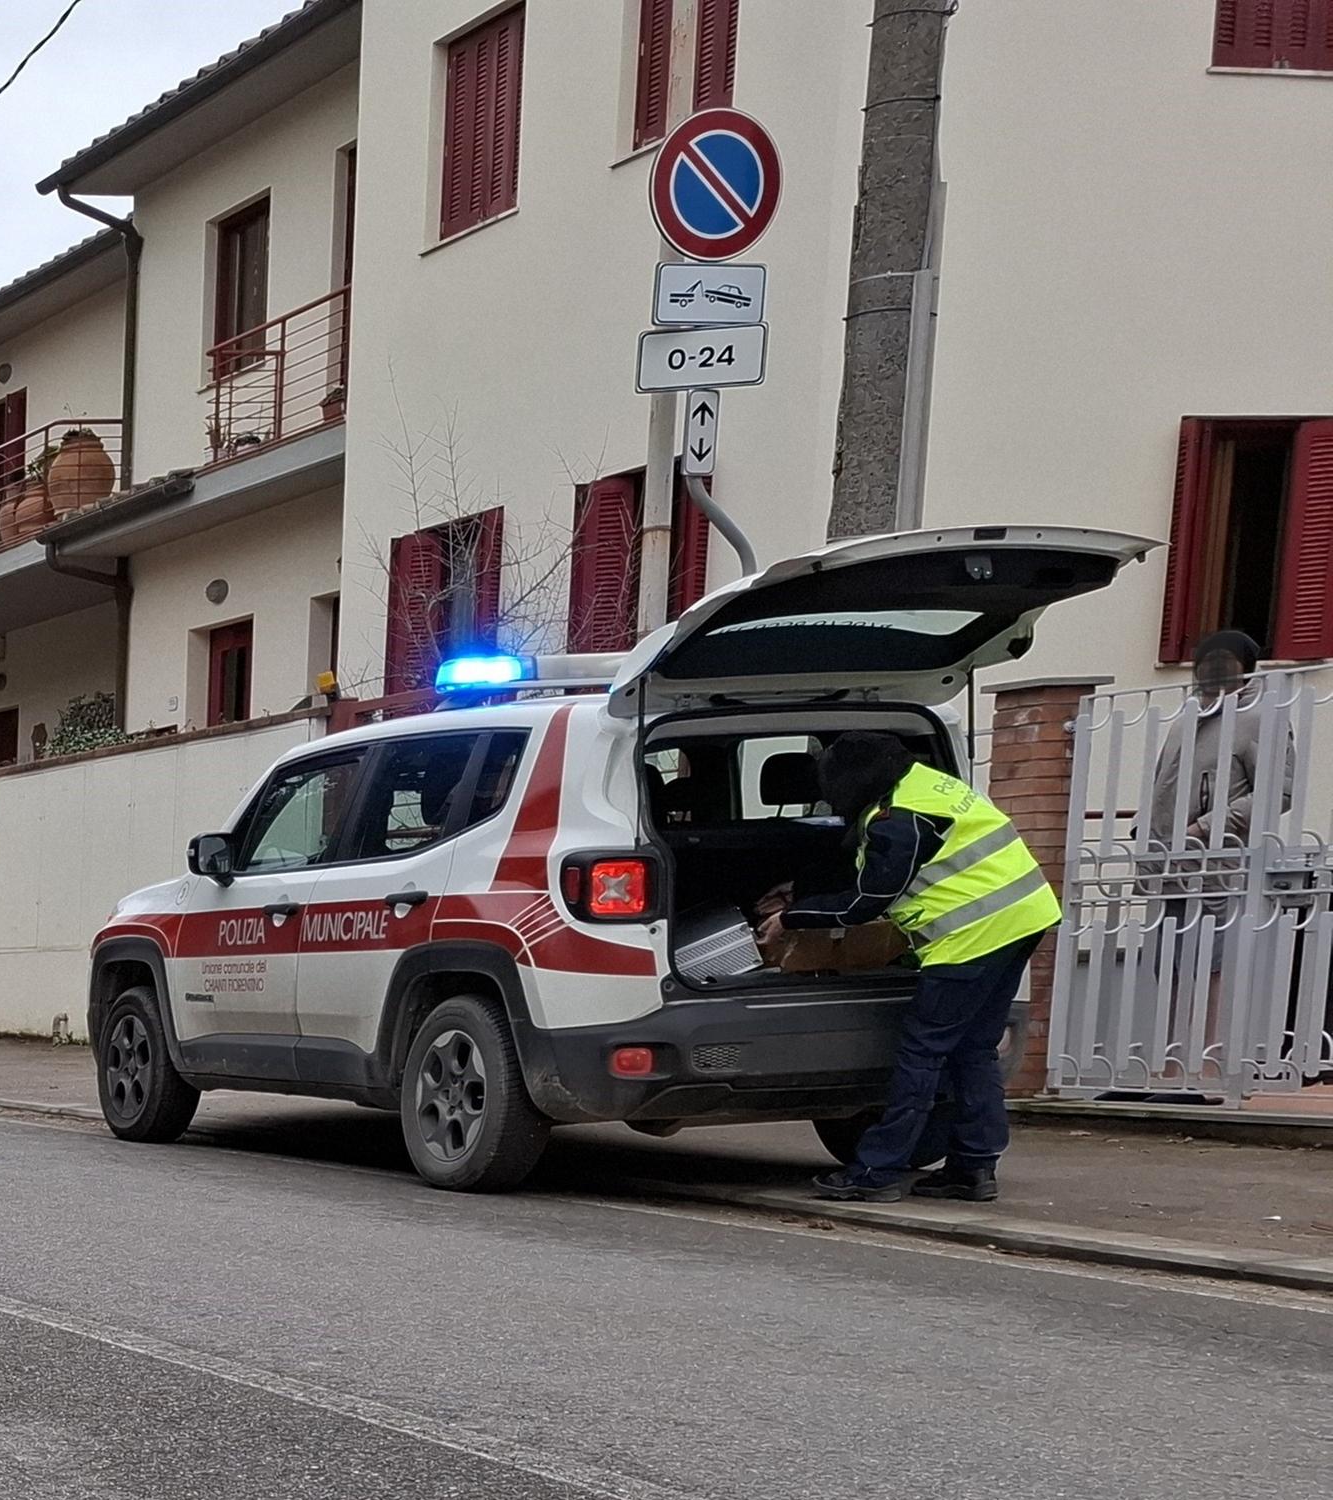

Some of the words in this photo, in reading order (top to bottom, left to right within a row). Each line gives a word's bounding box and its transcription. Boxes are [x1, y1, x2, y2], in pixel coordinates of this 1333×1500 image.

[668, 344, 735, 370] 0-24
[217, 917, 266, 946] POLIZIA
[302, 909, 390, 942] MUNICIPALE
